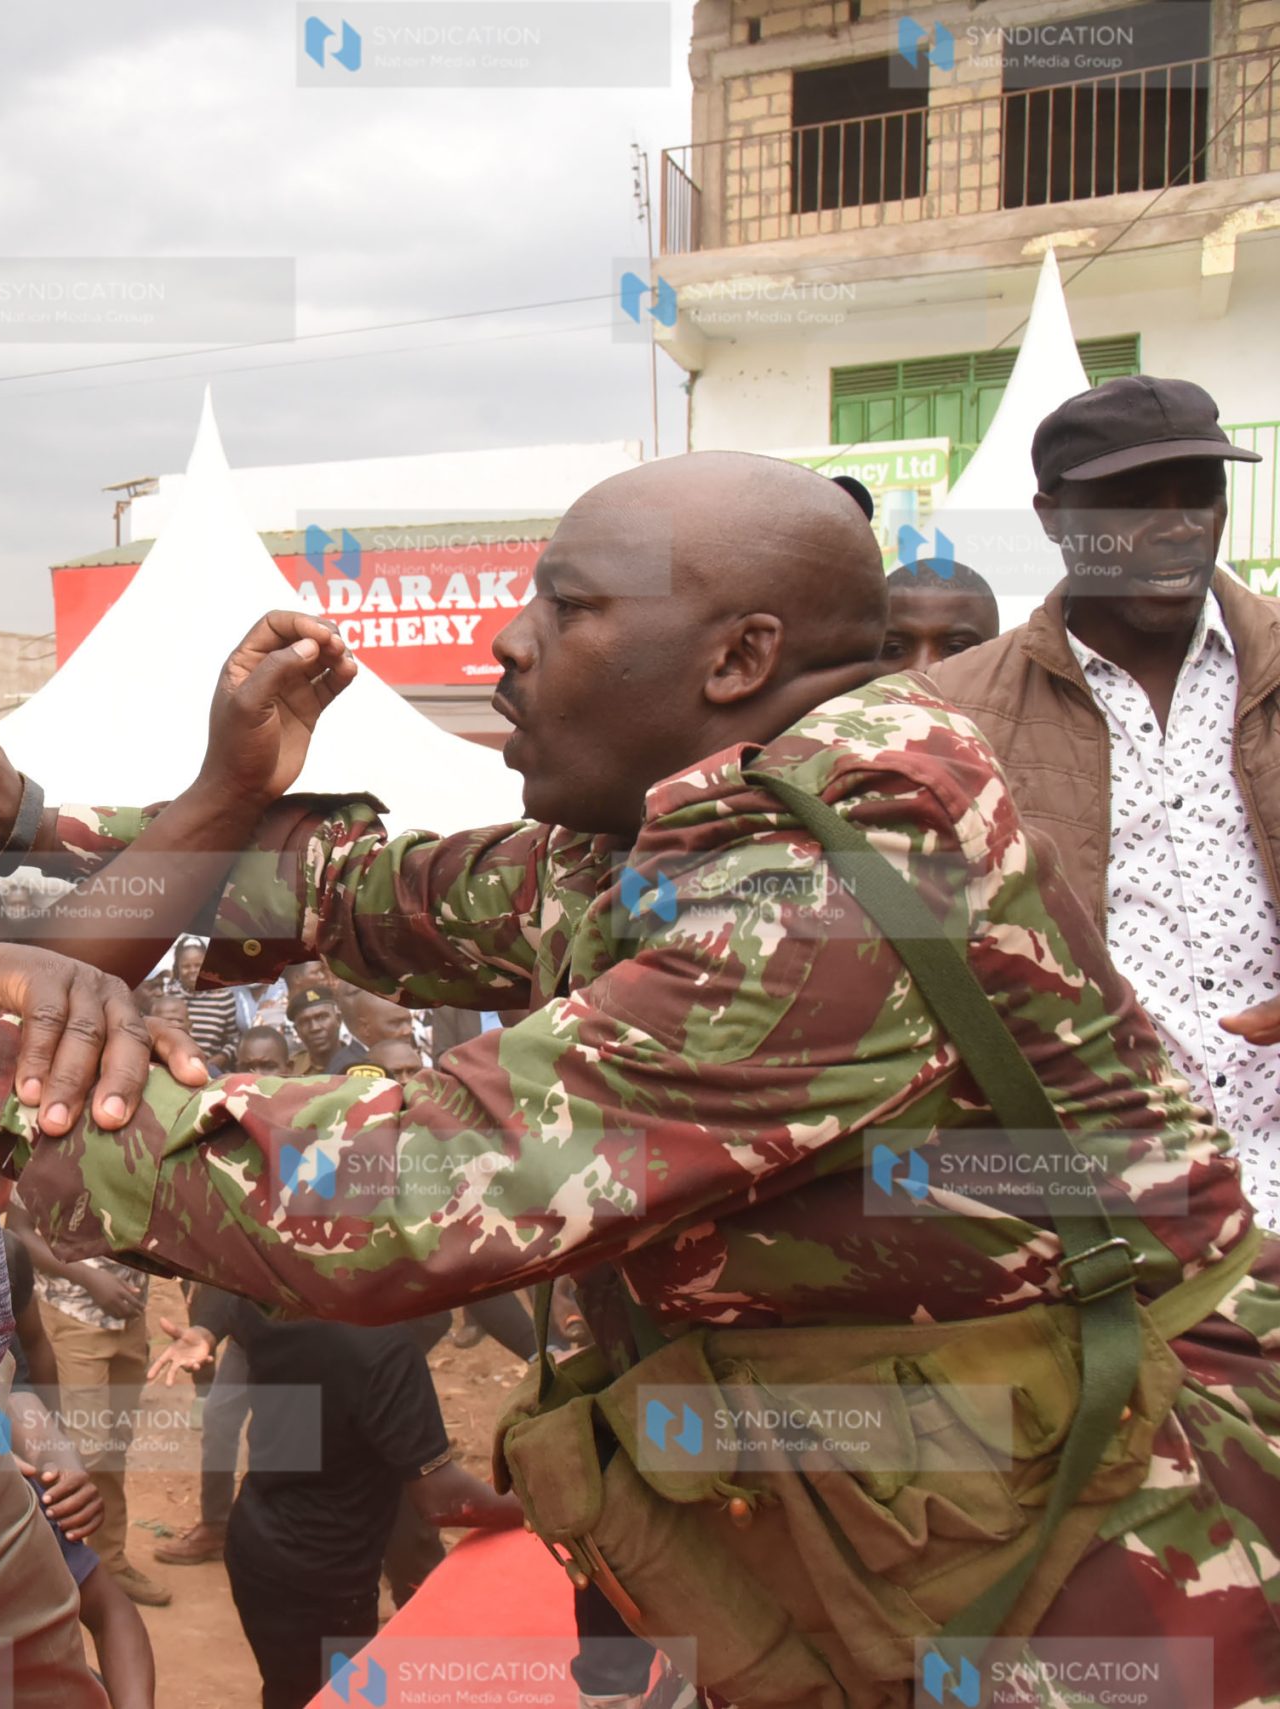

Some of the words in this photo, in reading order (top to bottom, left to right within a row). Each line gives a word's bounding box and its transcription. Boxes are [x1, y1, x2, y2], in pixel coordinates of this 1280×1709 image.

[801, 461, 889, 486] gency
[896, 453, 938, 479] Ltd
[333, 615, 482, 650] CHERY
